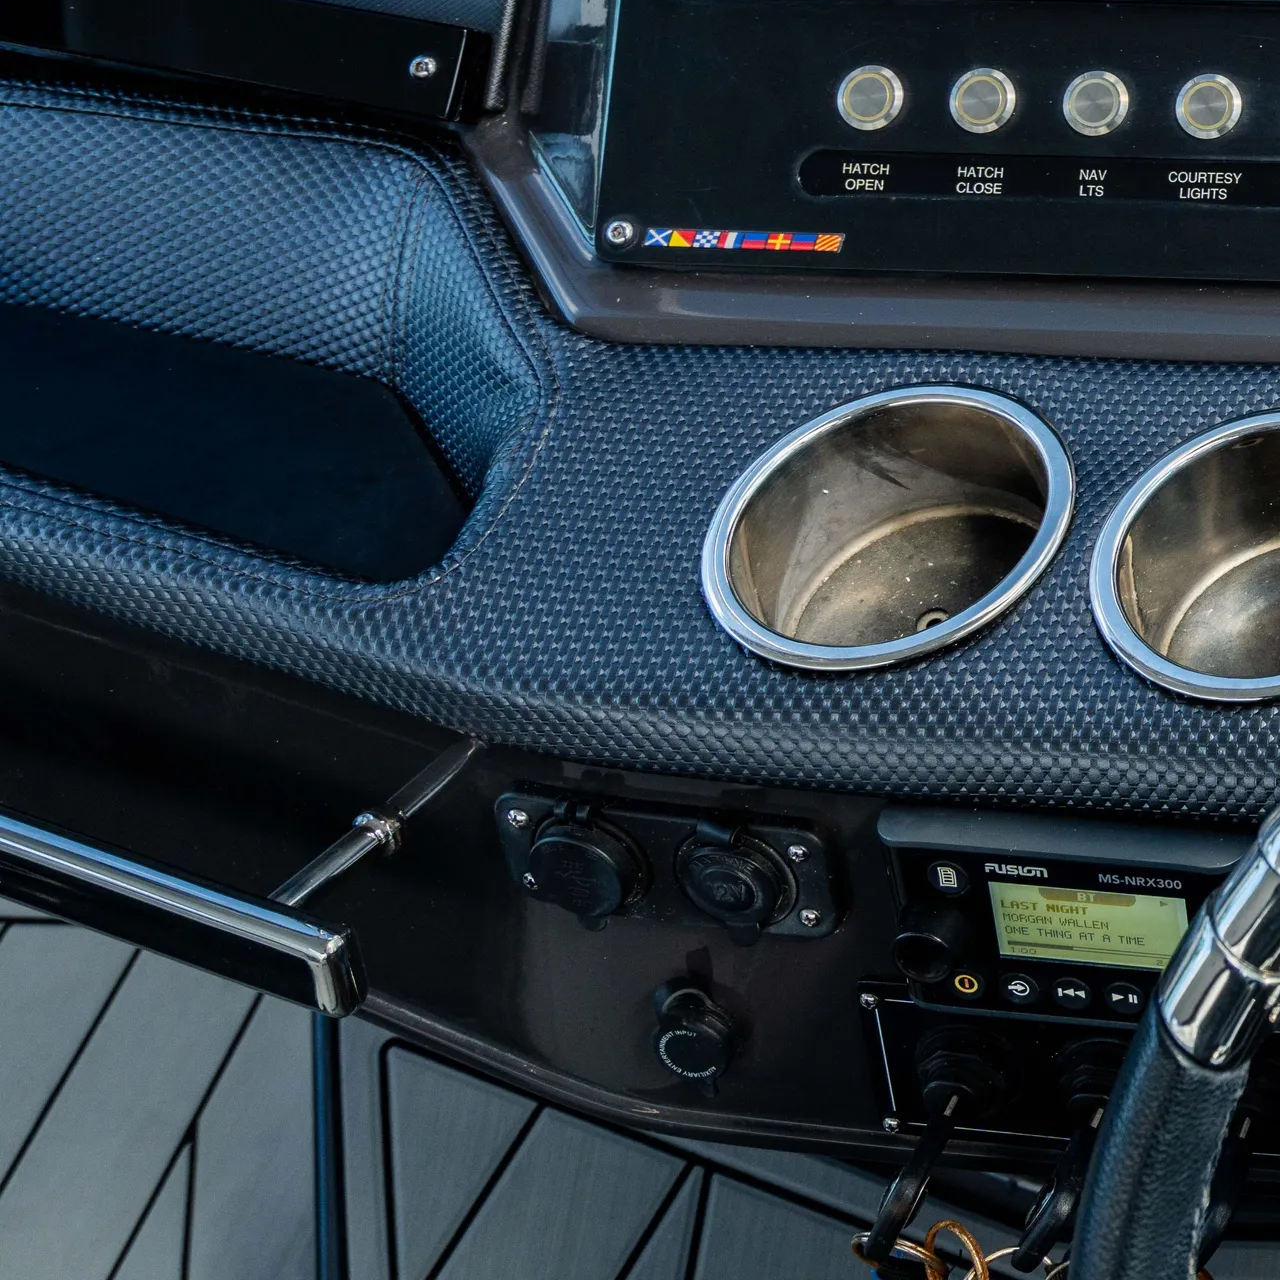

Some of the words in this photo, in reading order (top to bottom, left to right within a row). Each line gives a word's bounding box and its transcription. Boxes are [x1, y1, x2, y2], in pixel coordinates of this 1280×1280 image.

[842, 163, 890, 175] HATCH
[957, 166, 1004, 178] HATCH
[1079, 169, 1107, 181] NAV
[1168, 171, 1242, 184] COURTESY
[845, 179, 884, 191] OPEN
[956, 182, 1002, 195] CLOSE
[1079, 185, 1104, 197] LTS
[1179, 187, 1228, 200] LIGHTS
[1098, 873, 1182, 890] MS-NRX300
[1077, 892, 1096, 902] BT
[1000, 900, 1038, 910] LAST
[1046, 904, 1088, 915] NIGHT
[1002, 912, 1052, 925] MORGAN
[1059, 917, 1109, 930] WALLEN
[1005, 925, 1029, 936] ONE
[1036, 928, 1072, 940] THING
[1079, 932, 1094, 942] AT
[1102, 934, 1111, 943] A
[1118, 935, 1145, 946] TIME
[1010, 946, 1037, 955] 1:00
[674, 1030, 697, 1038] INPUT
[659, 1031, 682, 1074] ENTERTAINMENT
[682, 1066, 717, 1078] AUXILIARY
